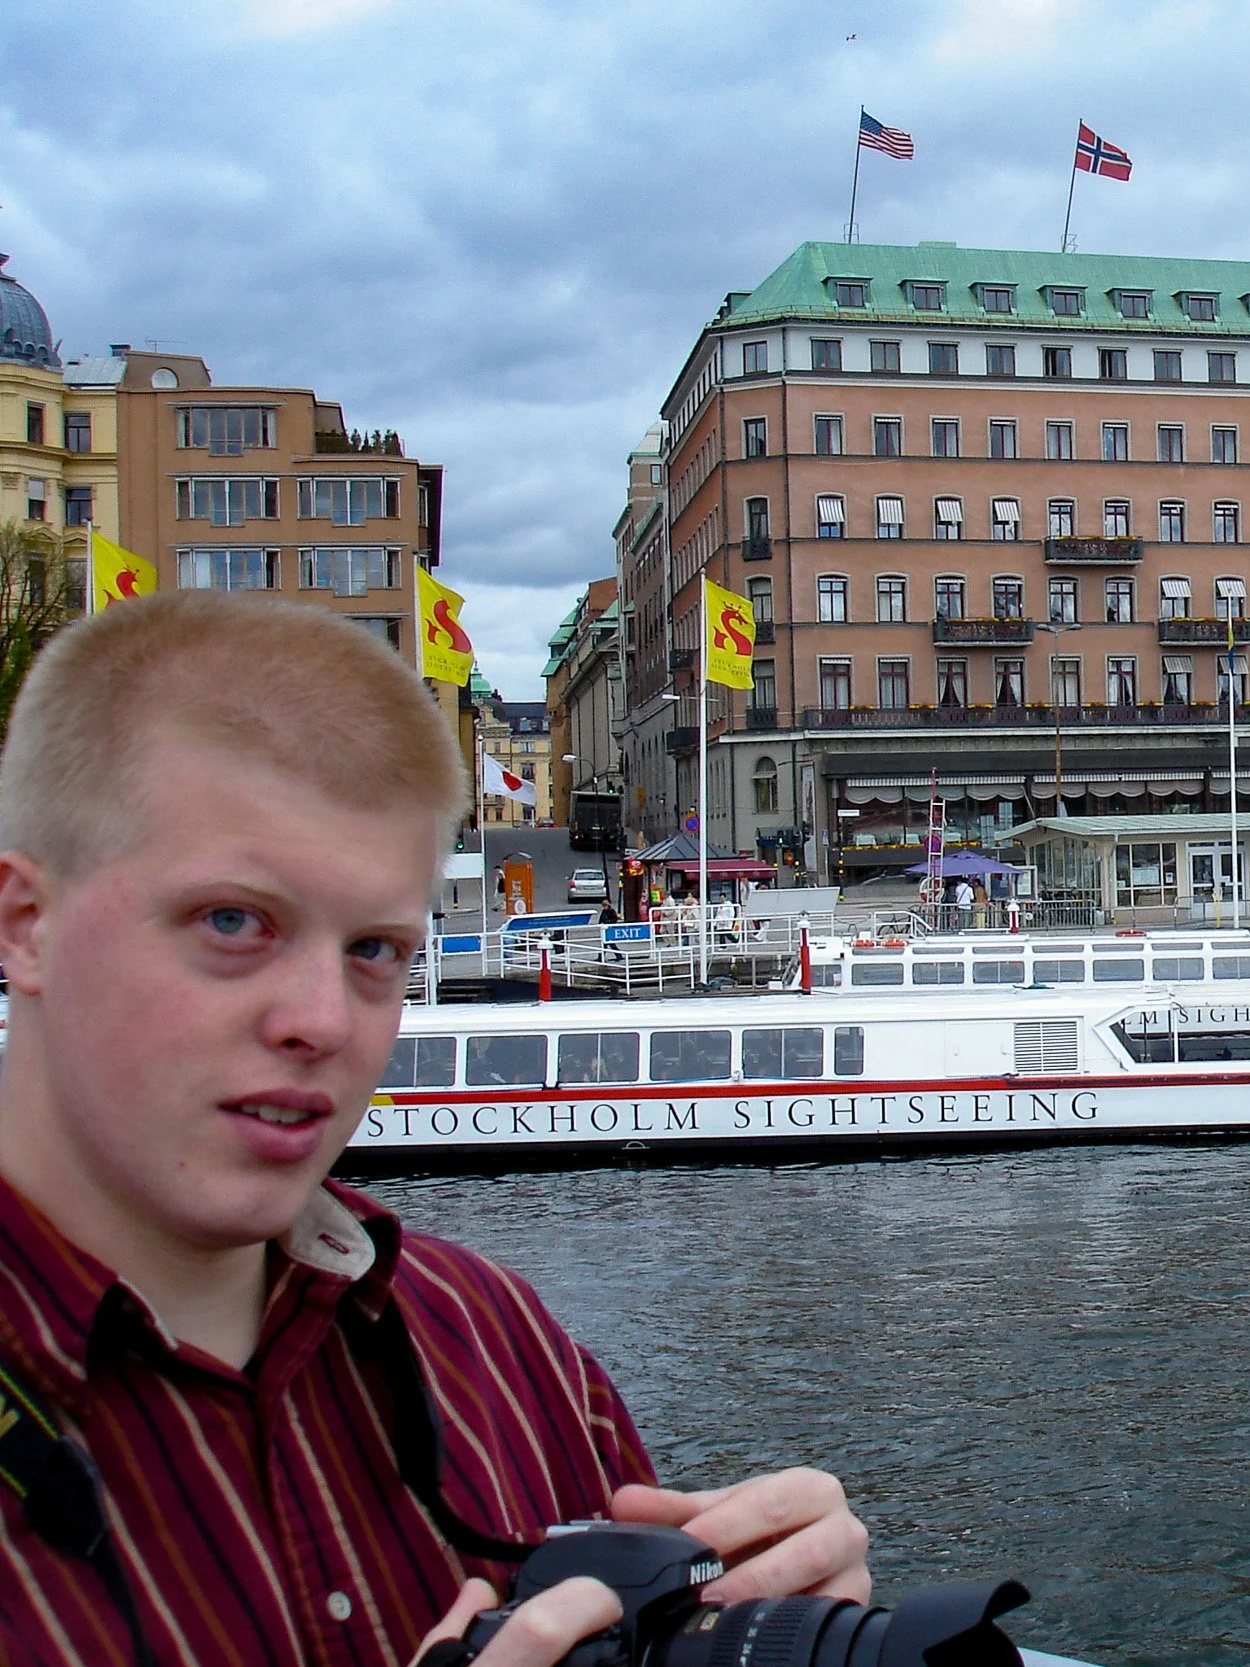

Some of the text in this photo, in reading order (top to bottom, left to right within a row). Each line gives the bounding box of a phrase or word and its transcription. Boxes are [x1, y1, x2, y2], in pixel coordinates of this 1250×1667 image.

[614, 927, 642, 939] EXIT
[366, 1091, 1099, 1138] STOCKHOLM SIGHTSEEING
[690, 1561, 724, 1585] Nikon
